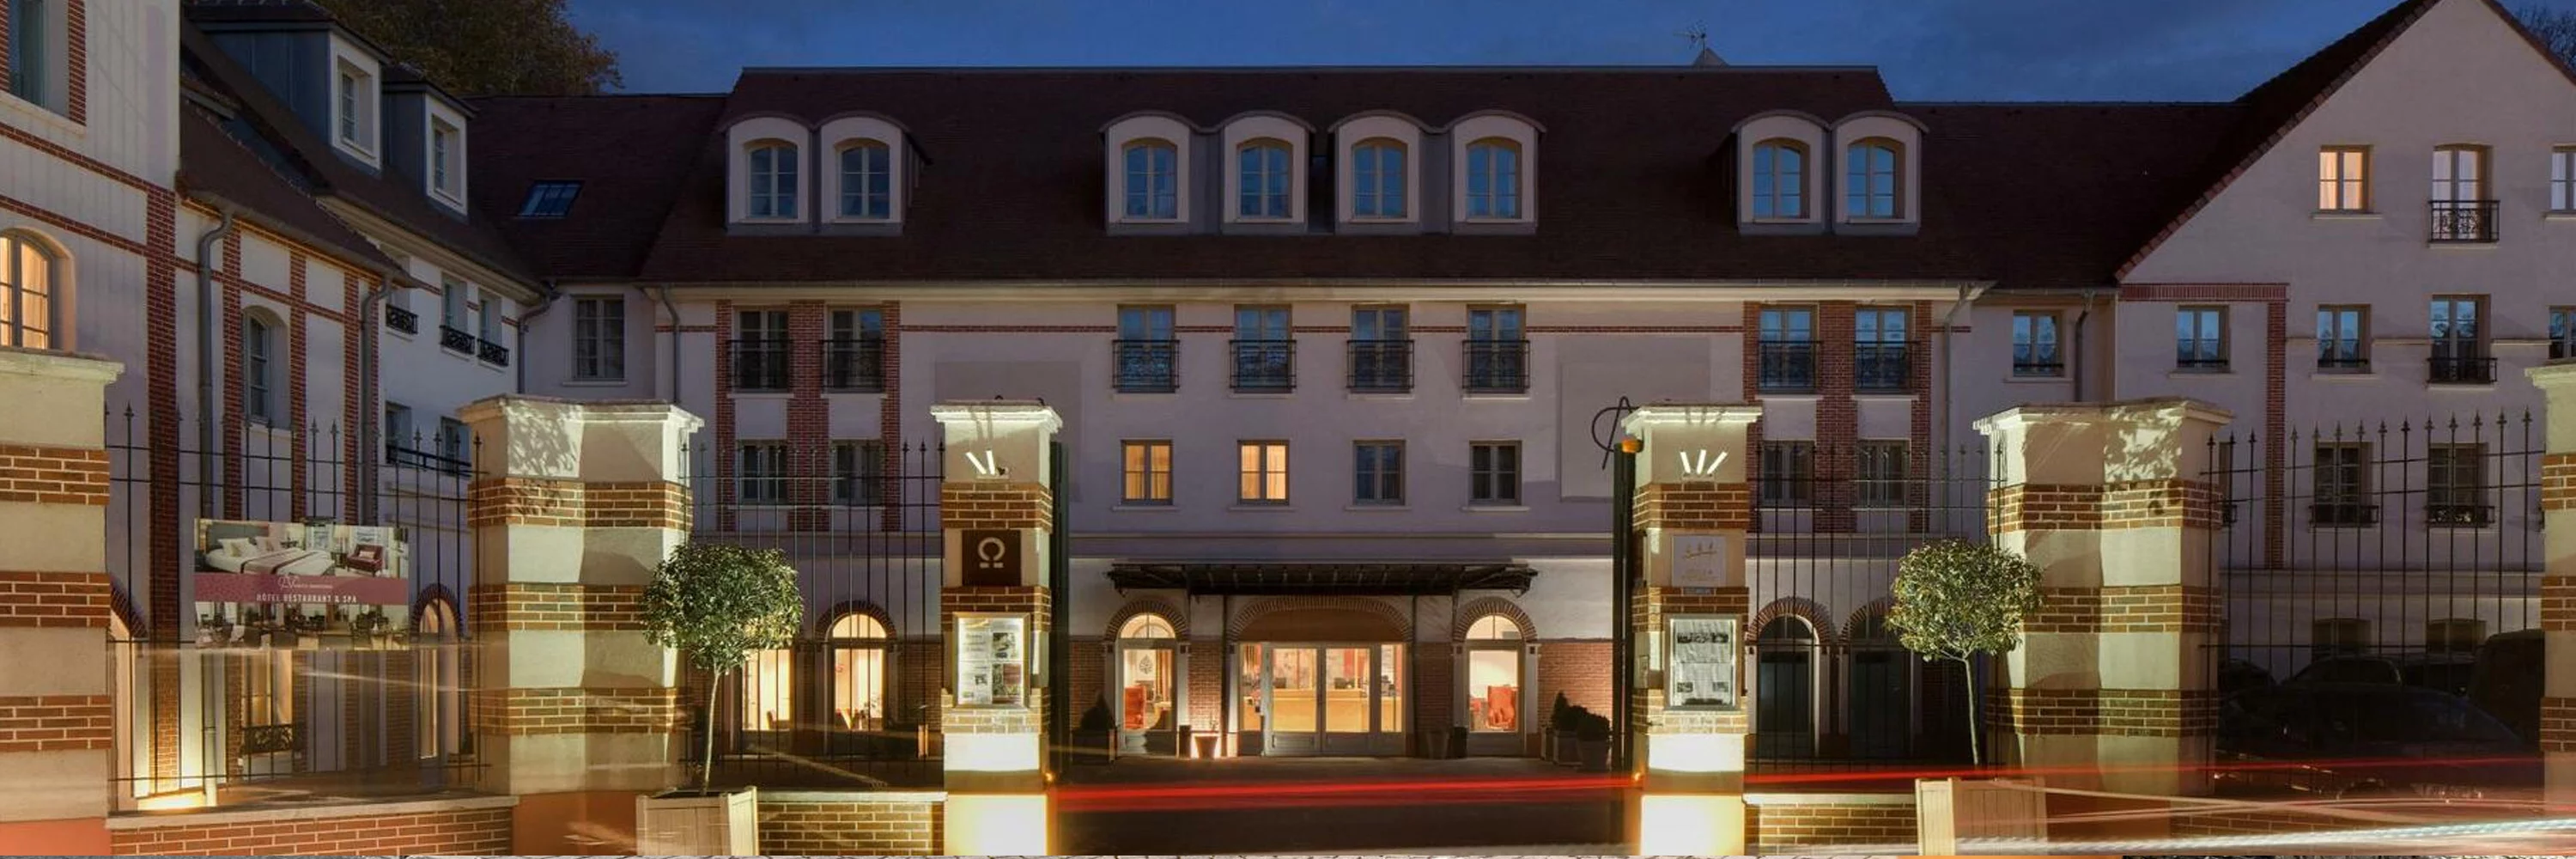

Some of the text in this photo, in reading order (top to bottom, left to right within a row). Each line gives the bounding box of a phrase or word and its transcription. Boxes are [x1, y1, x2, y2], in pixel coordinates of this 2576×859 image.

[283, 594, 331, 602] RESTAURANT
[334, 594, 340, 603] &
[343, 594, 357, 603] SPA
